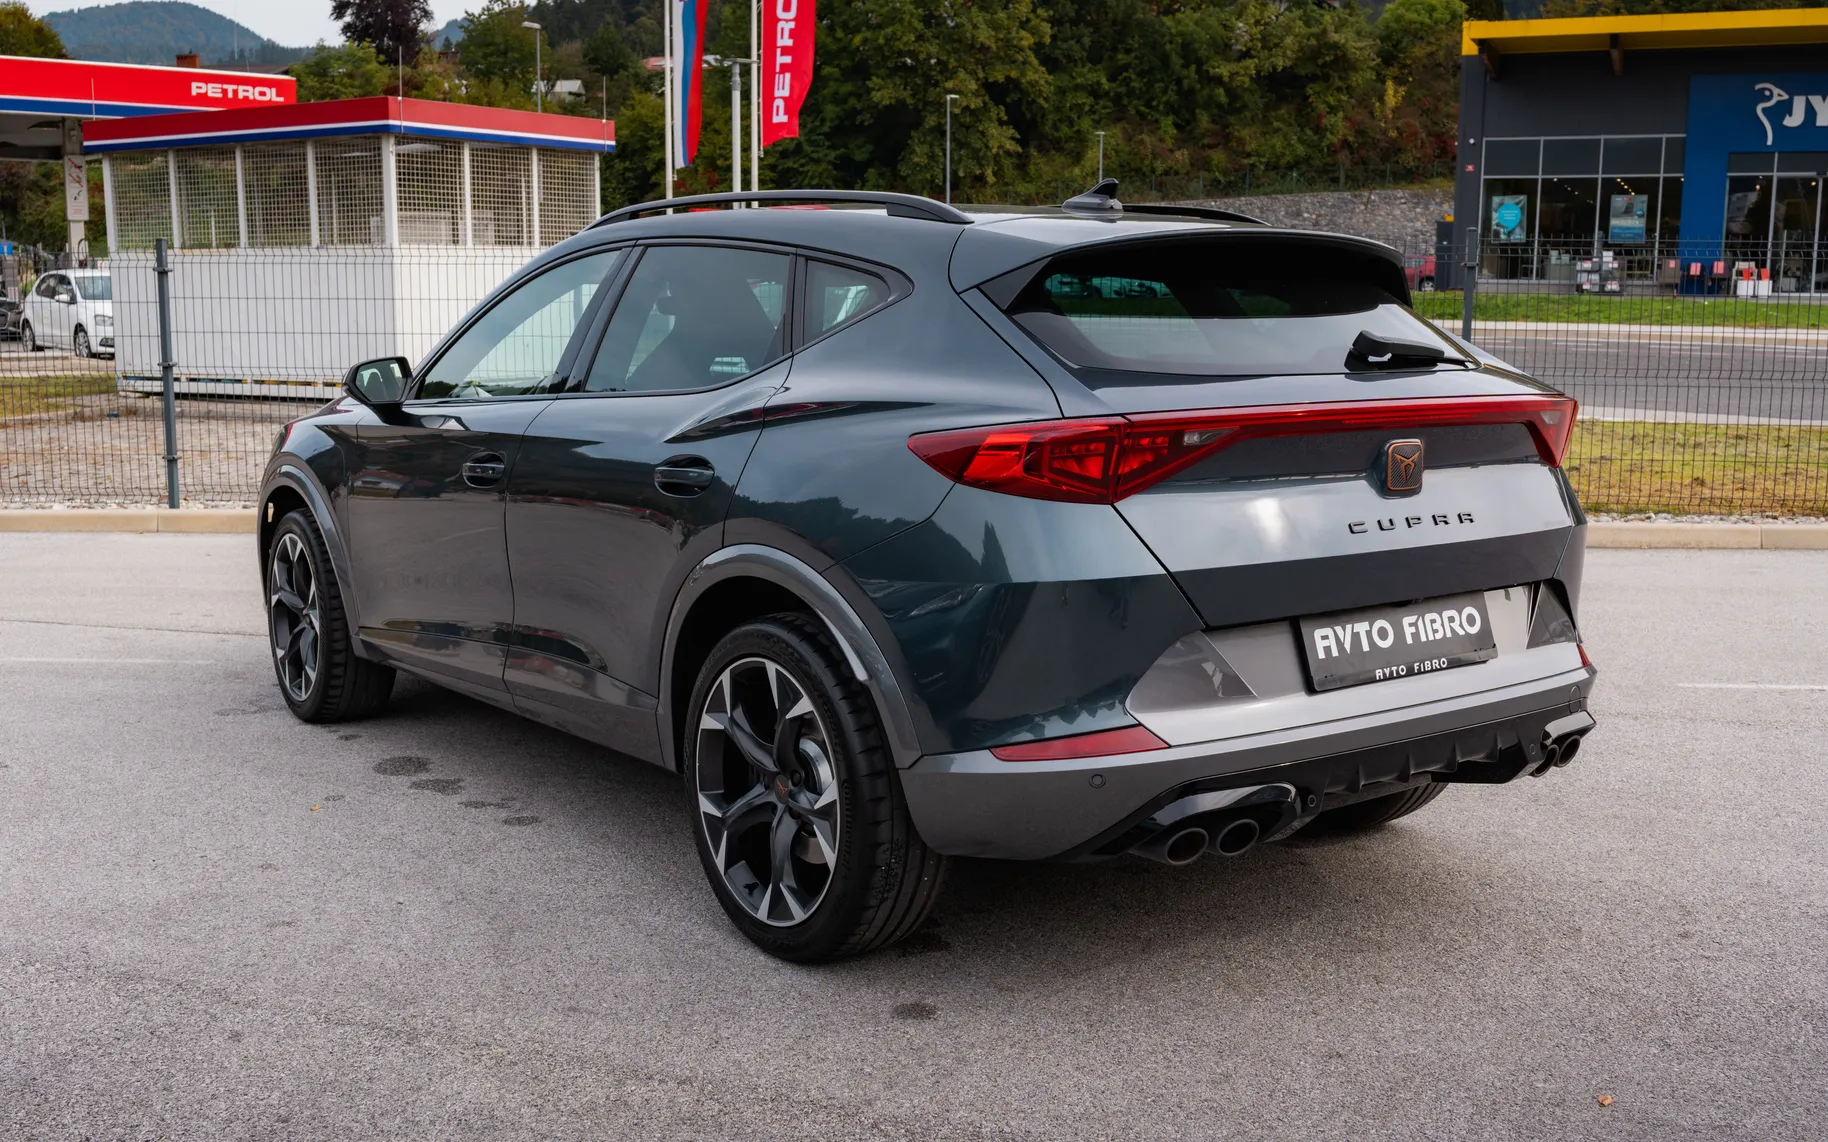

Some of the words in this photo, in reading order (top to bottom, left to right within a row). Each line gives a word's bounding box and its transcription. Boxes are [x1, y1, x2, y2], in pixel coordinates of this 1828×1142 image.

[191, 82, 284, 102] PETROL
[1348, 512, 1475, 534] CUPRA
[1314, 619, 1394, 659] AVTO
[1402, 606, 1481, 644] FIBRO
[1376, 665, 1406, 680] AVTO
[1414, 658, 1448, 673] FIBRO
